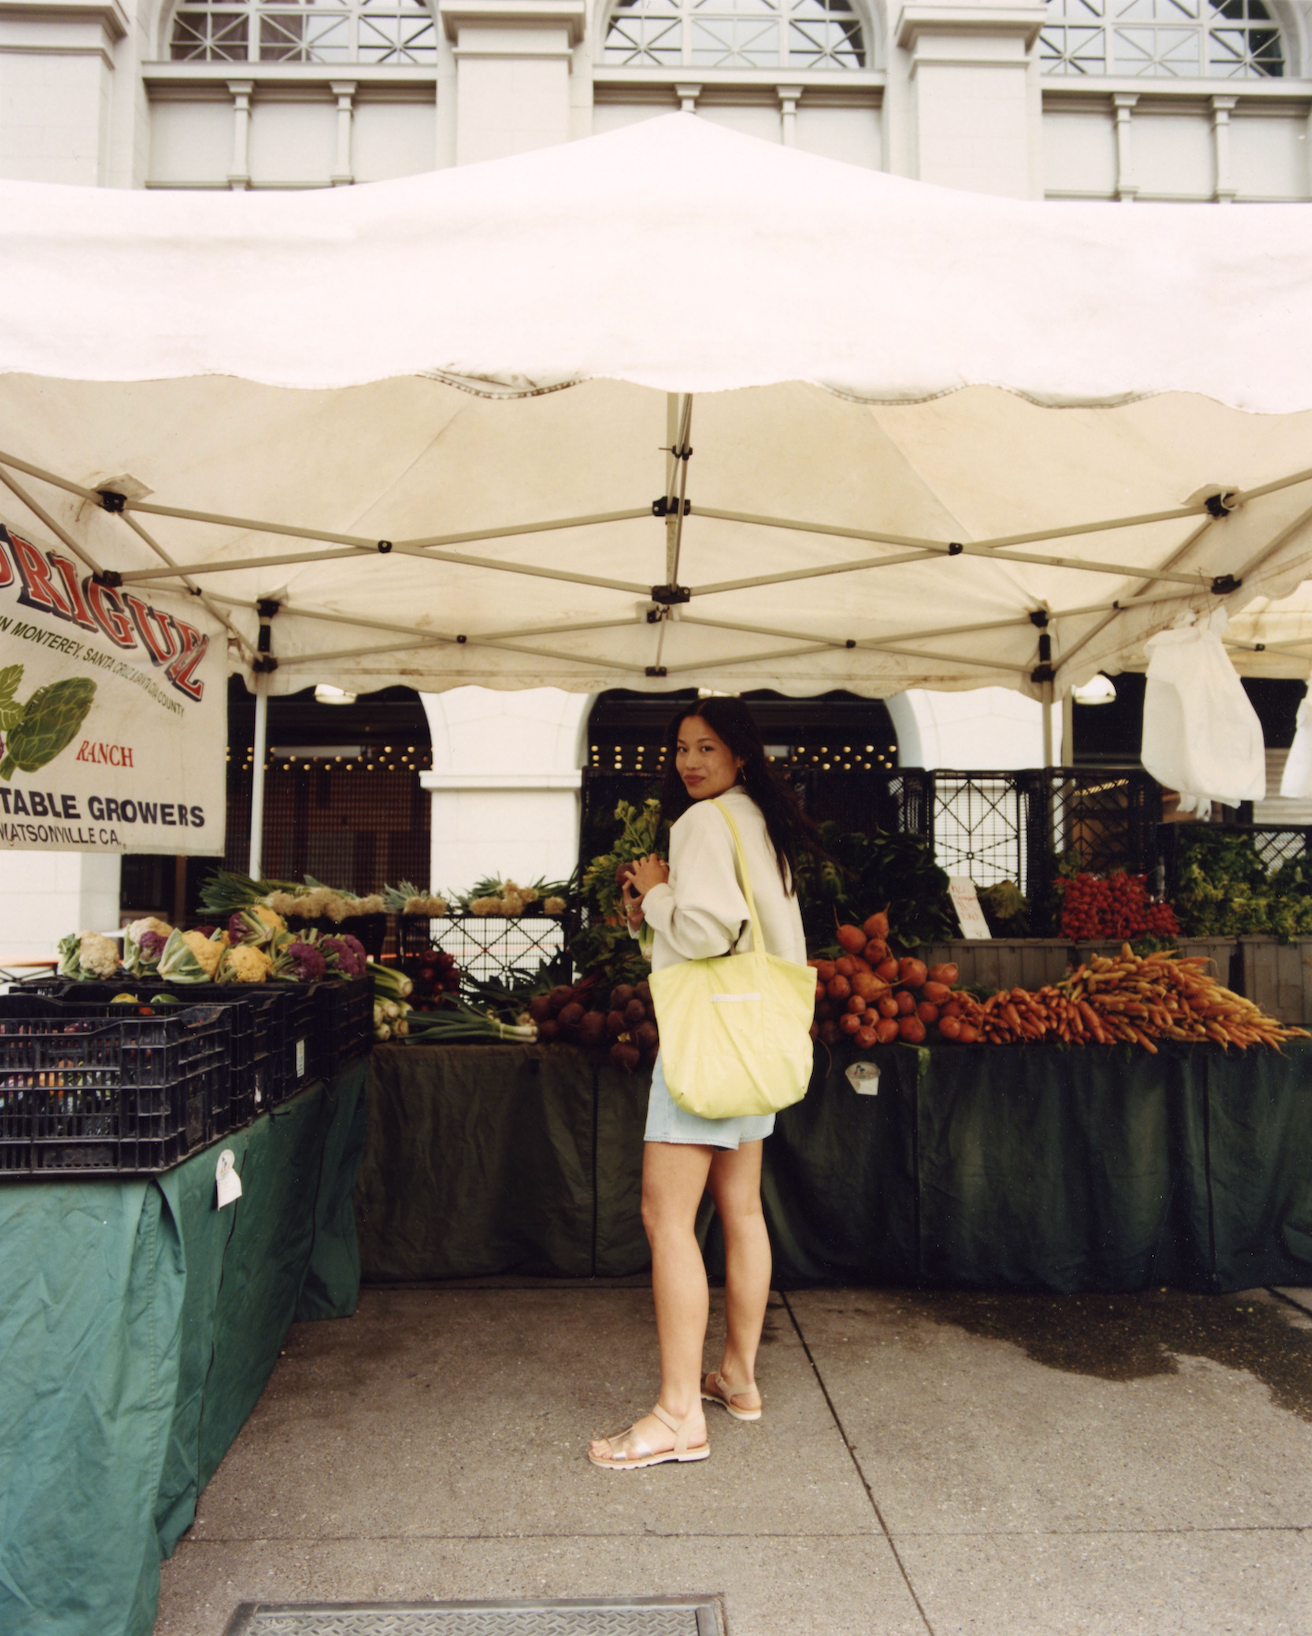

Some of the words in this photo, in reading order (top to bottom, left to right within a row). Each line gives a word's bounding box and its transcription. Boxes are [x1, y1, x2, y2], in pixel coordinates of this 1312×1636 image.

[10, 621, 84, 660] MONTEREY,
[83, 648, 115, 672] SANTA
[113, 661, 135, 680] CRUZ
[157, 691, 185, 718] COUNTY
[76, 740, 134, 768] RANCH
[87, 796, 205, 828] GROWERS
